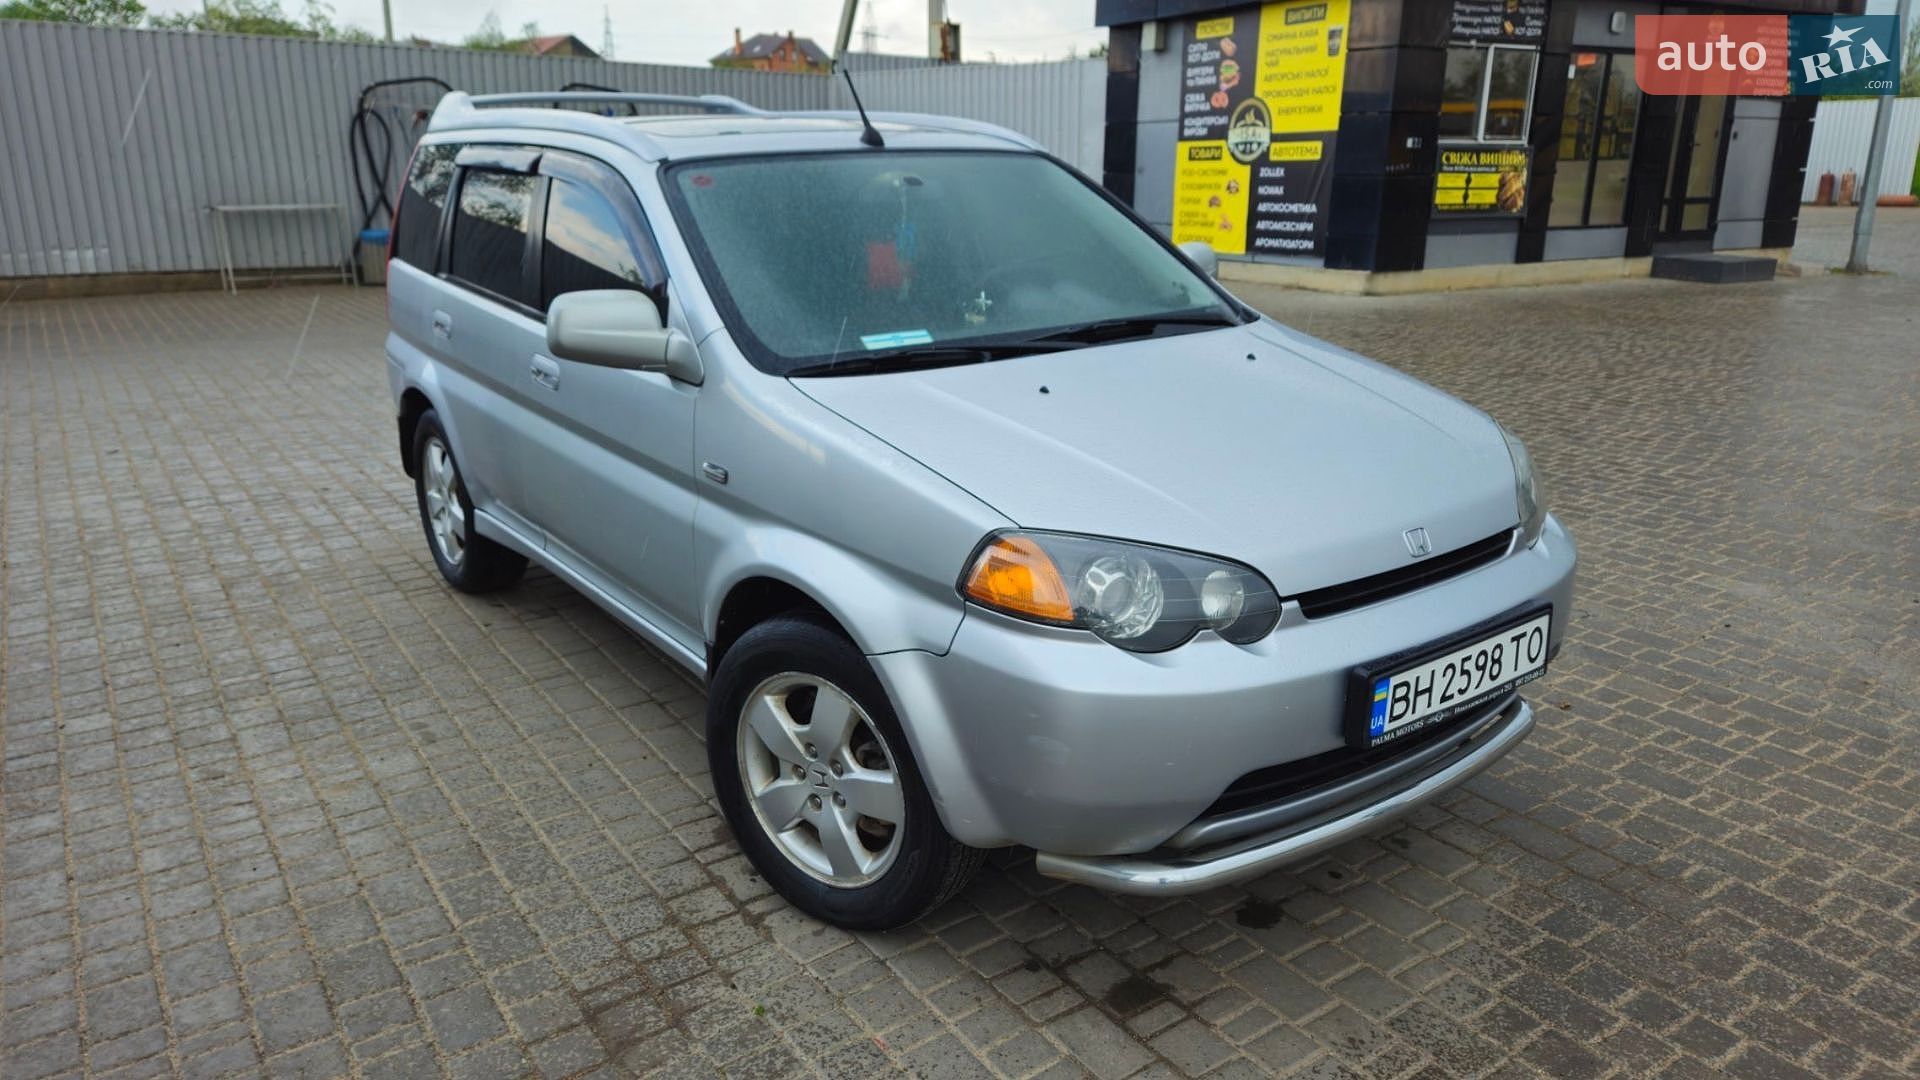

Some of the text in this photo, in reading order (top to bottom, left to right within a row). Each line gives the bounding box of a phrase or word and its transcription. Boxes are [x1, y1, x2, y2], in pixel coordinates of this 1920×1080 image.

[1191, 147, 1221, 159] ТОВАРИ
[1272, 144, 1319, 158] АВТОТЕМА
[1442, 151, 1478, 165] СВІЖА
[1259, 167, 1285, 178] ZOLLEX
[1257, 203, 1318, 213] АВТОКОСМЕТИКА
[1255, 237, 1314, 249] АРОМАТИЗАТОРИ
[1388, 626, 1543, 723] BH 2598 TO
[1371, 714, 1384, 729] UA
[1371, 720, 1424, 747] PALMA MOTORS
